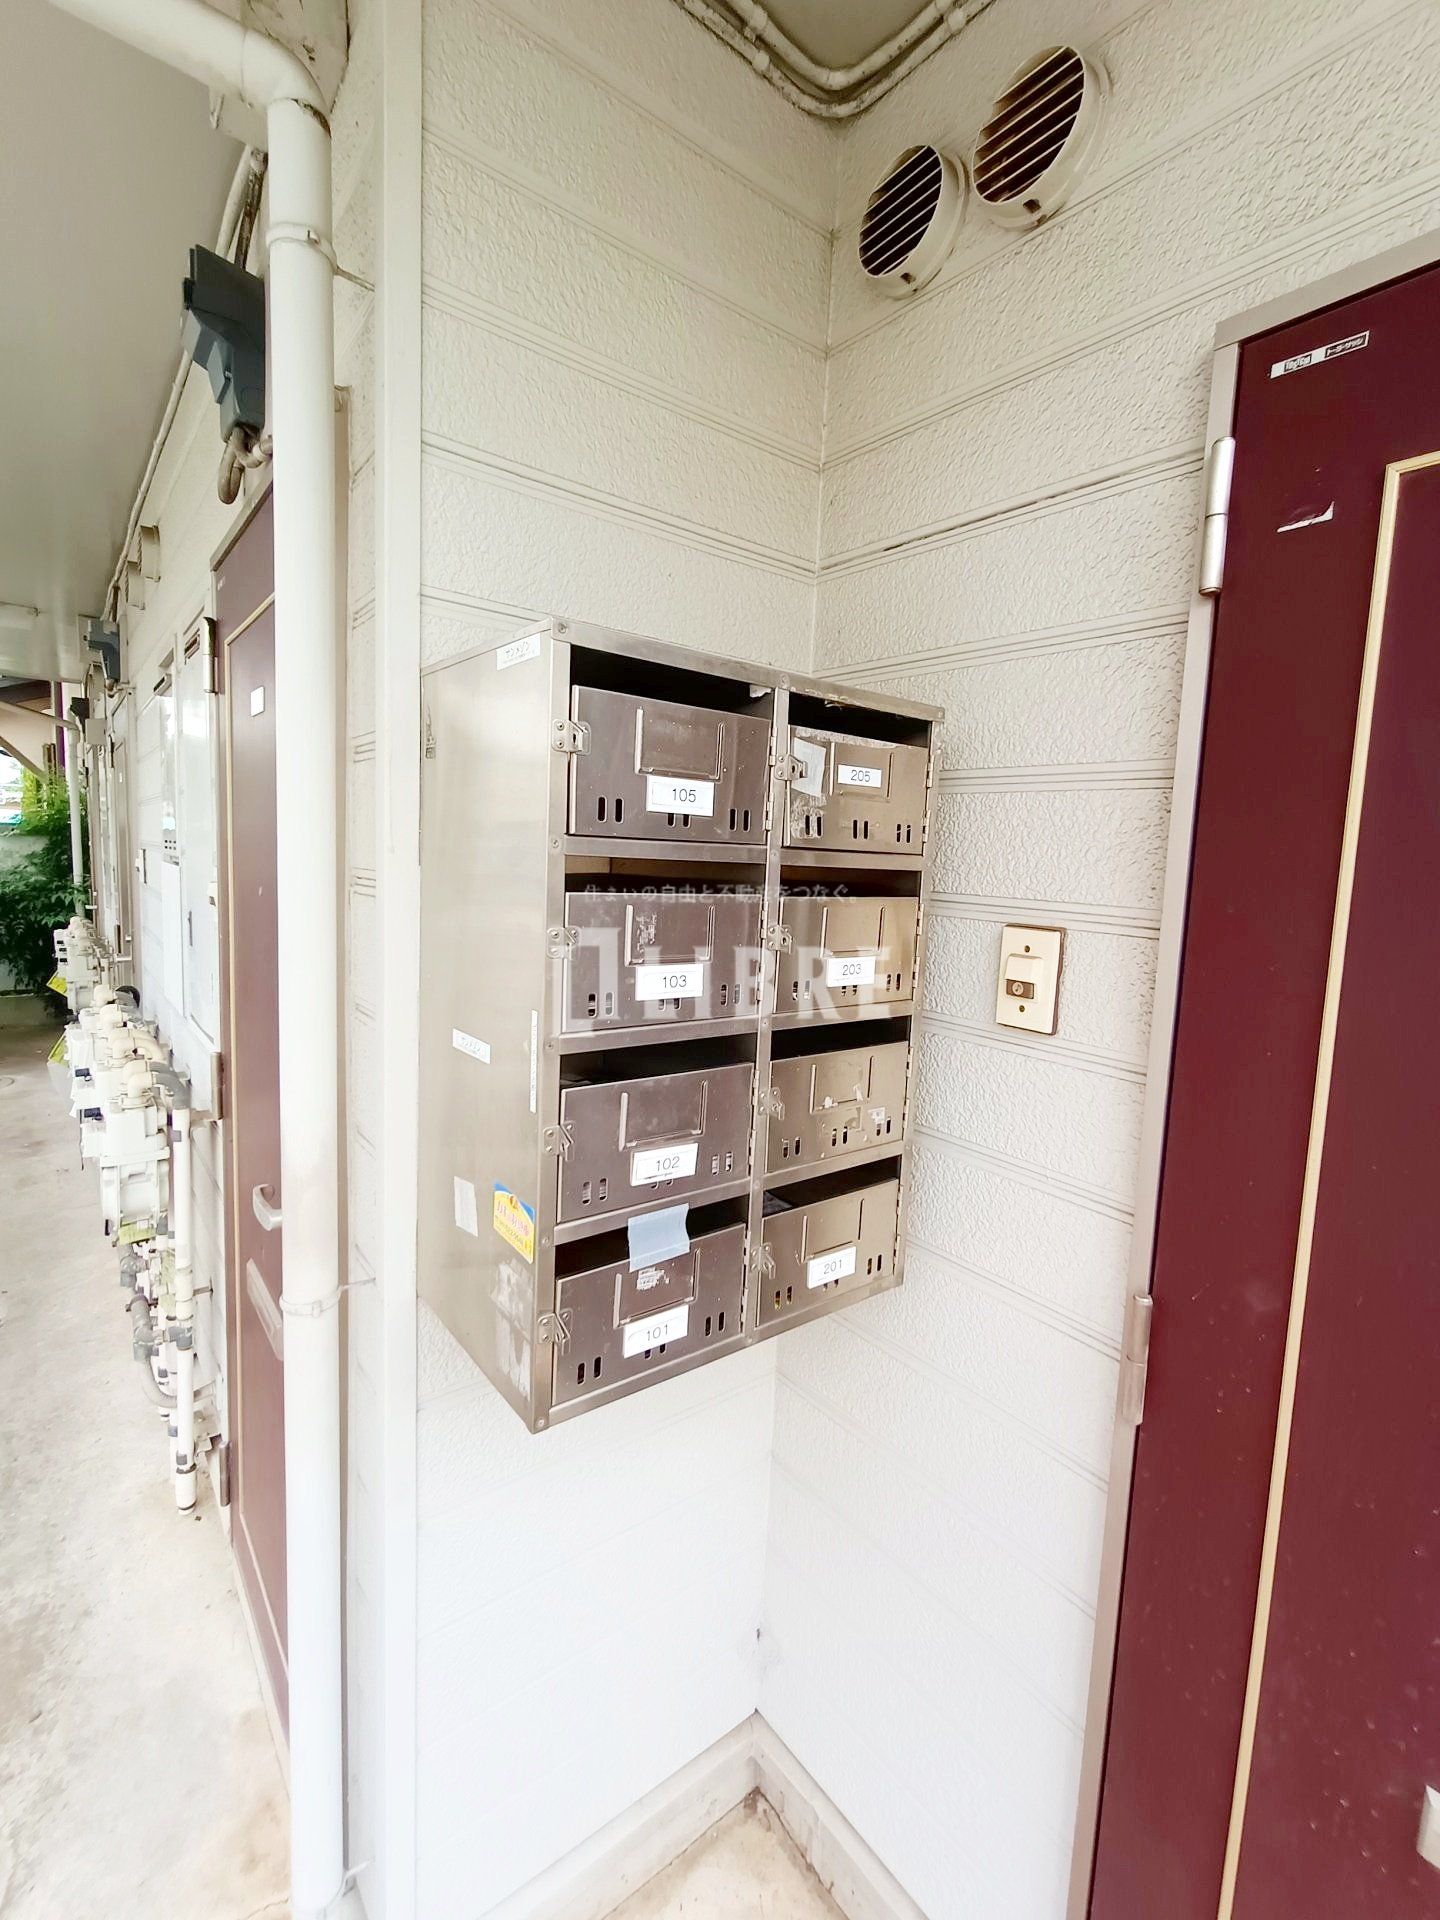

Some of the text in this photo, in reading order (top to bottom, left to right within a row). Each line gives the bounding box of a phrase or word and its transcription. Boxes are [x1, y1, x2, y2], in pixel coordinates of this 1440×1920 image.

[850, 769, 870, 783] 205
[672, 788, 697, 803] 105
[842, 963, 861, 976] 203
[662, 975, 687, 989] 103
[656, 1155, 680, 1171] 102
[824, 1259, 843, 1274] 201
[646, 1323, 669, 1340] 101
